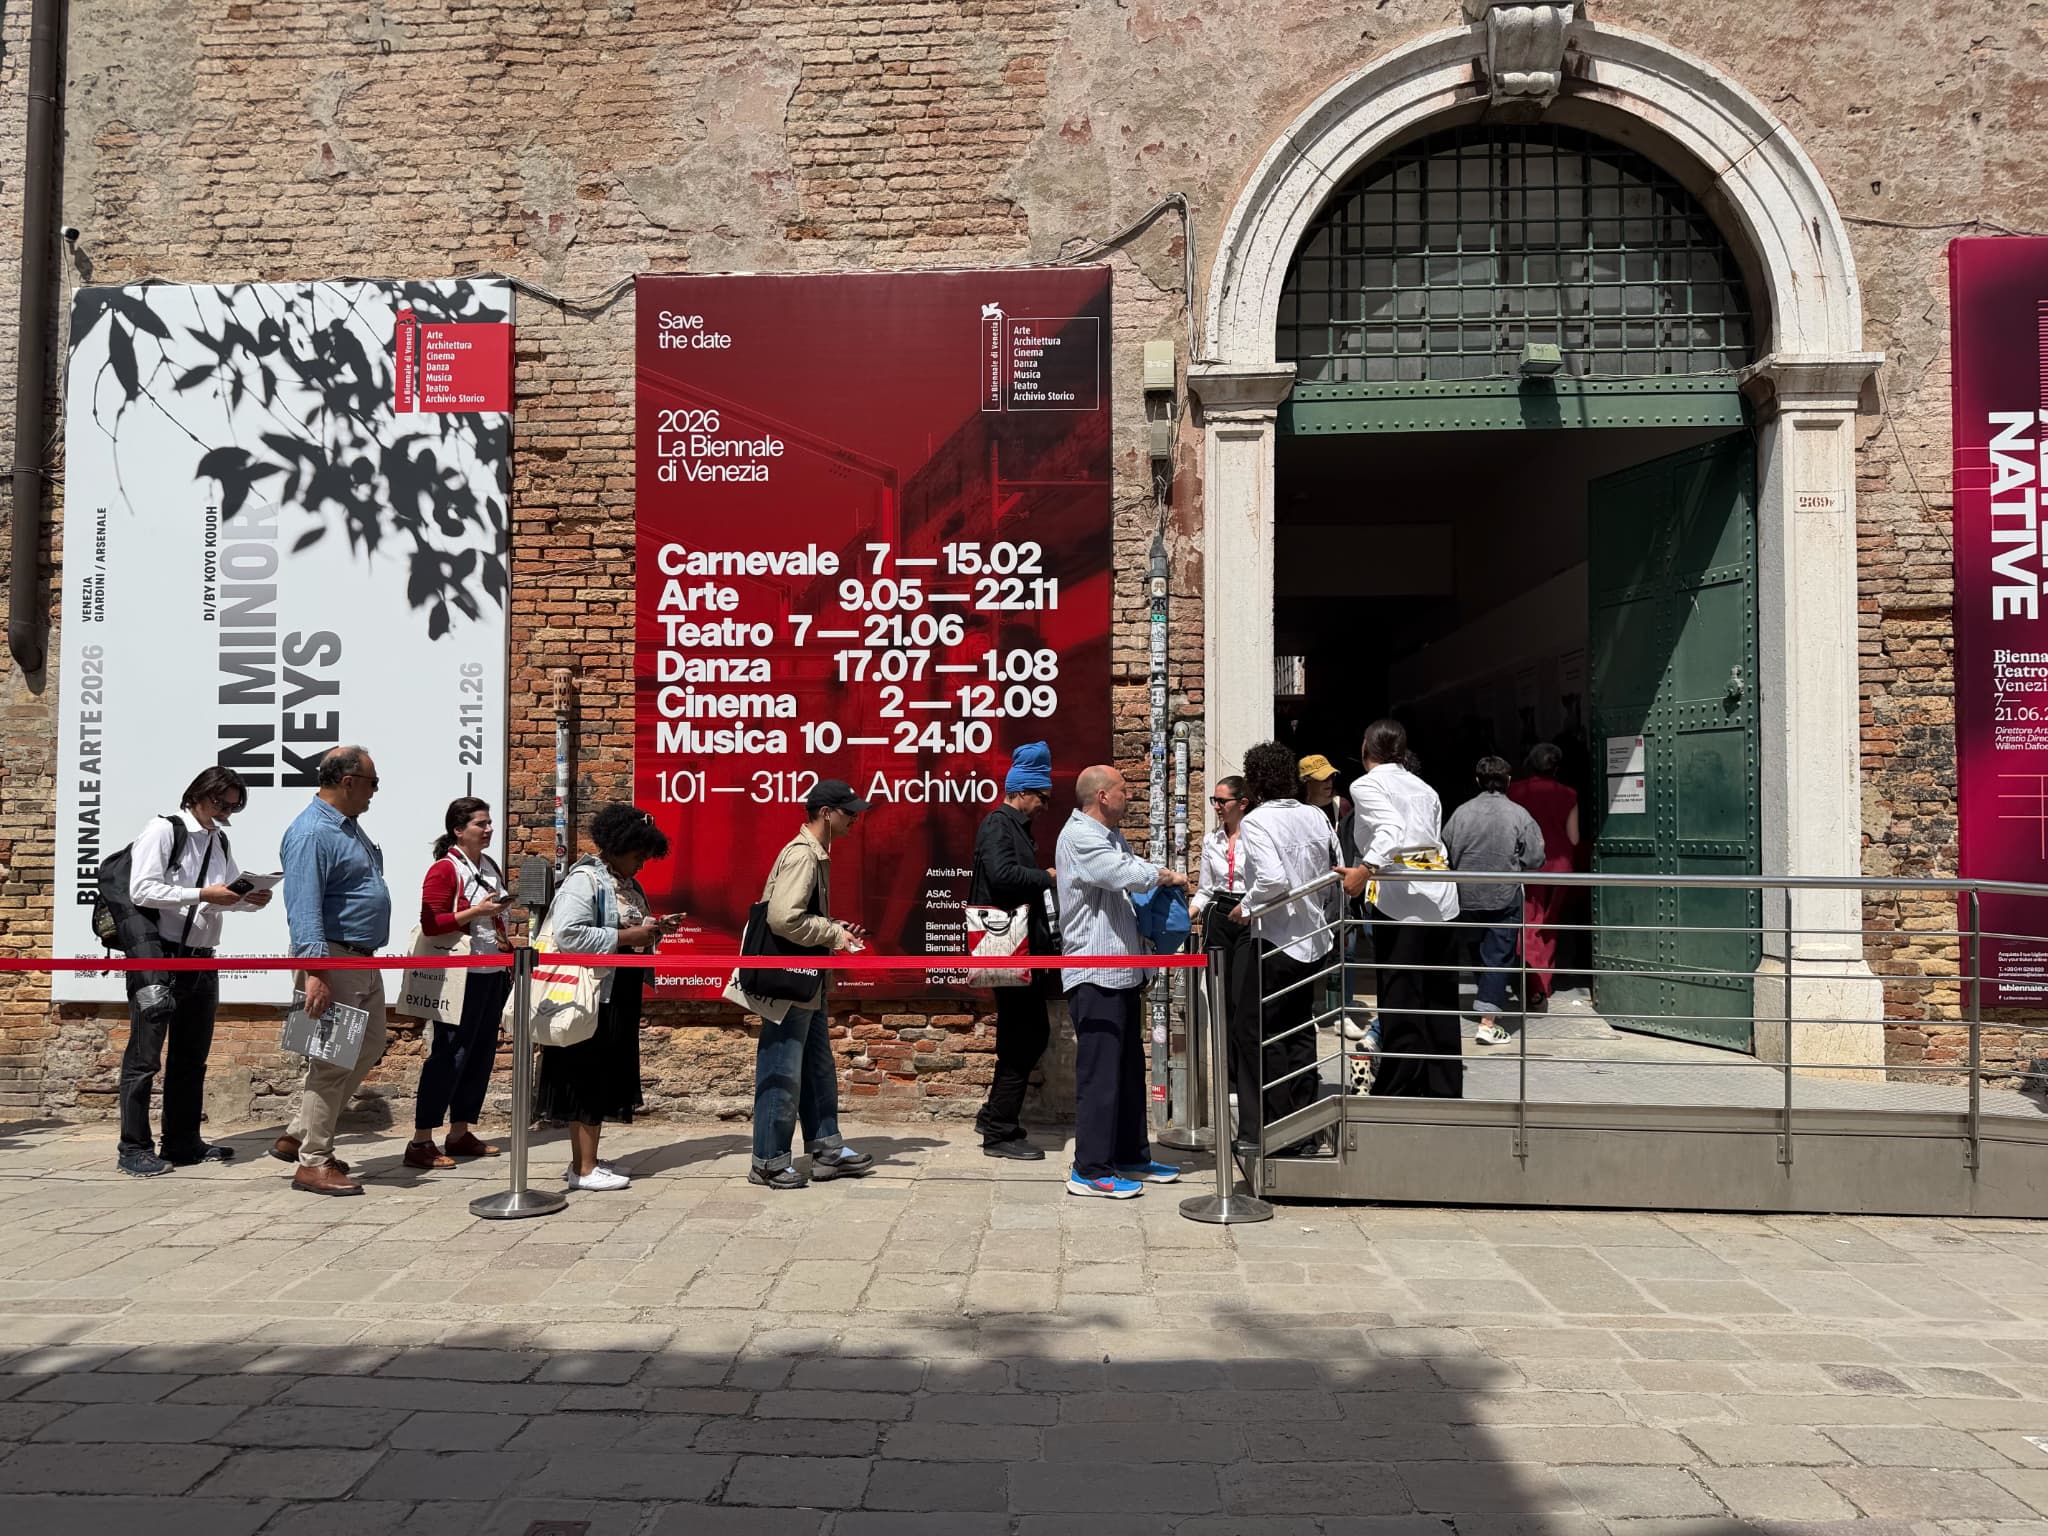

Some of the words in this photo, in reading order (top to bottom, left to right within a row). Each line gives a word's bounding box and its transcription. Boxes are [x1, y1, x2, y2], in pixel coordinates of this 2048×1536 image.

[658, 311, 704, 330] Save
[426, 331, 443, 339] Arte
[658, 330, 687, 348] the
[691, 330, 731, 348] date
[991, 322, 999, 350] Venezia
[1013, 326, 1031, 334] Arte
[404, 327, 412, 354] Venezia
[426, 341, 472, 350] Architettura
[1013, 337, 1061, 346] Architettura
[404, 355, 412, 363] di
[426, 352, 455, 360] Cinema
[991, 351, 999, 359] di
[1013, 348, 1044, 357] Cinema
[426, 363, 450, 371] Danza
[1013, 359, 1038, 368] Danza
[403, 364, 412, 394] Biennale
[426, 373, 452, 382] Musica
[991, 360, 999, 392] Biennale
[1013, 370, 1041, 379] Musica
[426, 384, 449, 392] Teatro
[1013, 381, 1038, 390] Teatro
[426, 394, 456, 403] Archivio
[458, 394, 485, 402] Storico
[1013, 392, 1046, 401] Archivio
[1047, 391, 1075, 401] Storico
[657, 410, 720, 433] 2026
[657, 436, 685, 457] La
[691, 435, 784, 457] Biennale
[657, 460, 676, 482] di
[681, 460, 769, 482] Venezia
[1988, 411, 2039, 621] NATIVE
[95, 507, 107, 563] ARSENALE
[205, 506, 218, 548] KOUOH
[204, 551, 217, 582] KOYO
[657, 543, 839, 576] Carnevale
[82, 576, 93, 622] VENEZIA
[94, 574, 105, 622] GIARDINI
[203, 585, 216, 621] DI/BY
[218, 501, 279, 705] MINOR
[657, 579, 739, 611] Arte
[657, 614, 774, 647] Teatro
[1993, 649, 2048, 663] Bienna
[81, 644, 104, 705] 2026
[657, 651, 771, 683] Danza
[1993, 664, 2048, 678] Teatro
[1993, 678, 2048, 692] Venezi
[281, 631, 342, 787] KEYS
[657, 686, 797, 719] Cinema
[458, 662, 484, 766] 22.11.26
[657, 723, 788, 755] Musica
[1995, 726, 2033, 734] Direttore
[80, 710, 103, 775] ARTE
[865, 770, 998, 803] Archivio
[76, 779, 101, 905] BIENNALE
[926, 868, 956, 877] Attività
[926, 889, 952, 898] ASAC
[926, 900, 960, 909] Archivio
[925, 921, 961, 930] Biennale
[925, 932, 961, 941] Biennale
[925, 943, 961, 952] Biennale
[932, 975, 946, 984] Ca'
[406, 994, 451, 1011] exibart
